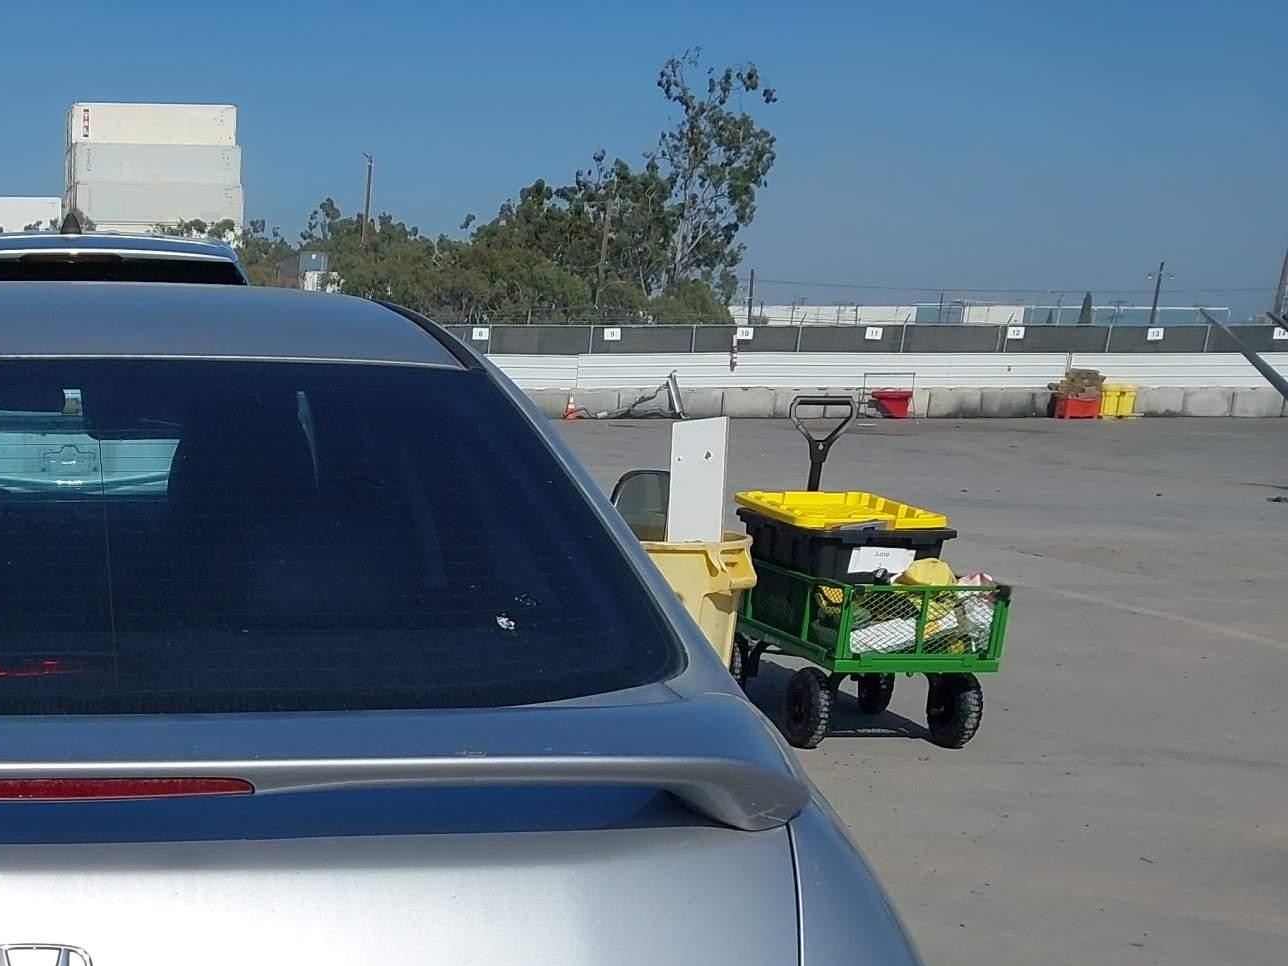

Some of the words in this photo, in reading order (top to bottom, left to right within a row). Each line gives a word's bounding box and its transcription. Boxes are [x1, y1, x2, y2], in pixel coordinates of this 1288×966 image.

[741, 329, 749, 337] 10
[870, 329, 878, 337] 11
[1012, 329, 1021, 337] 12
[1152, 330, 1160, 338] 13
